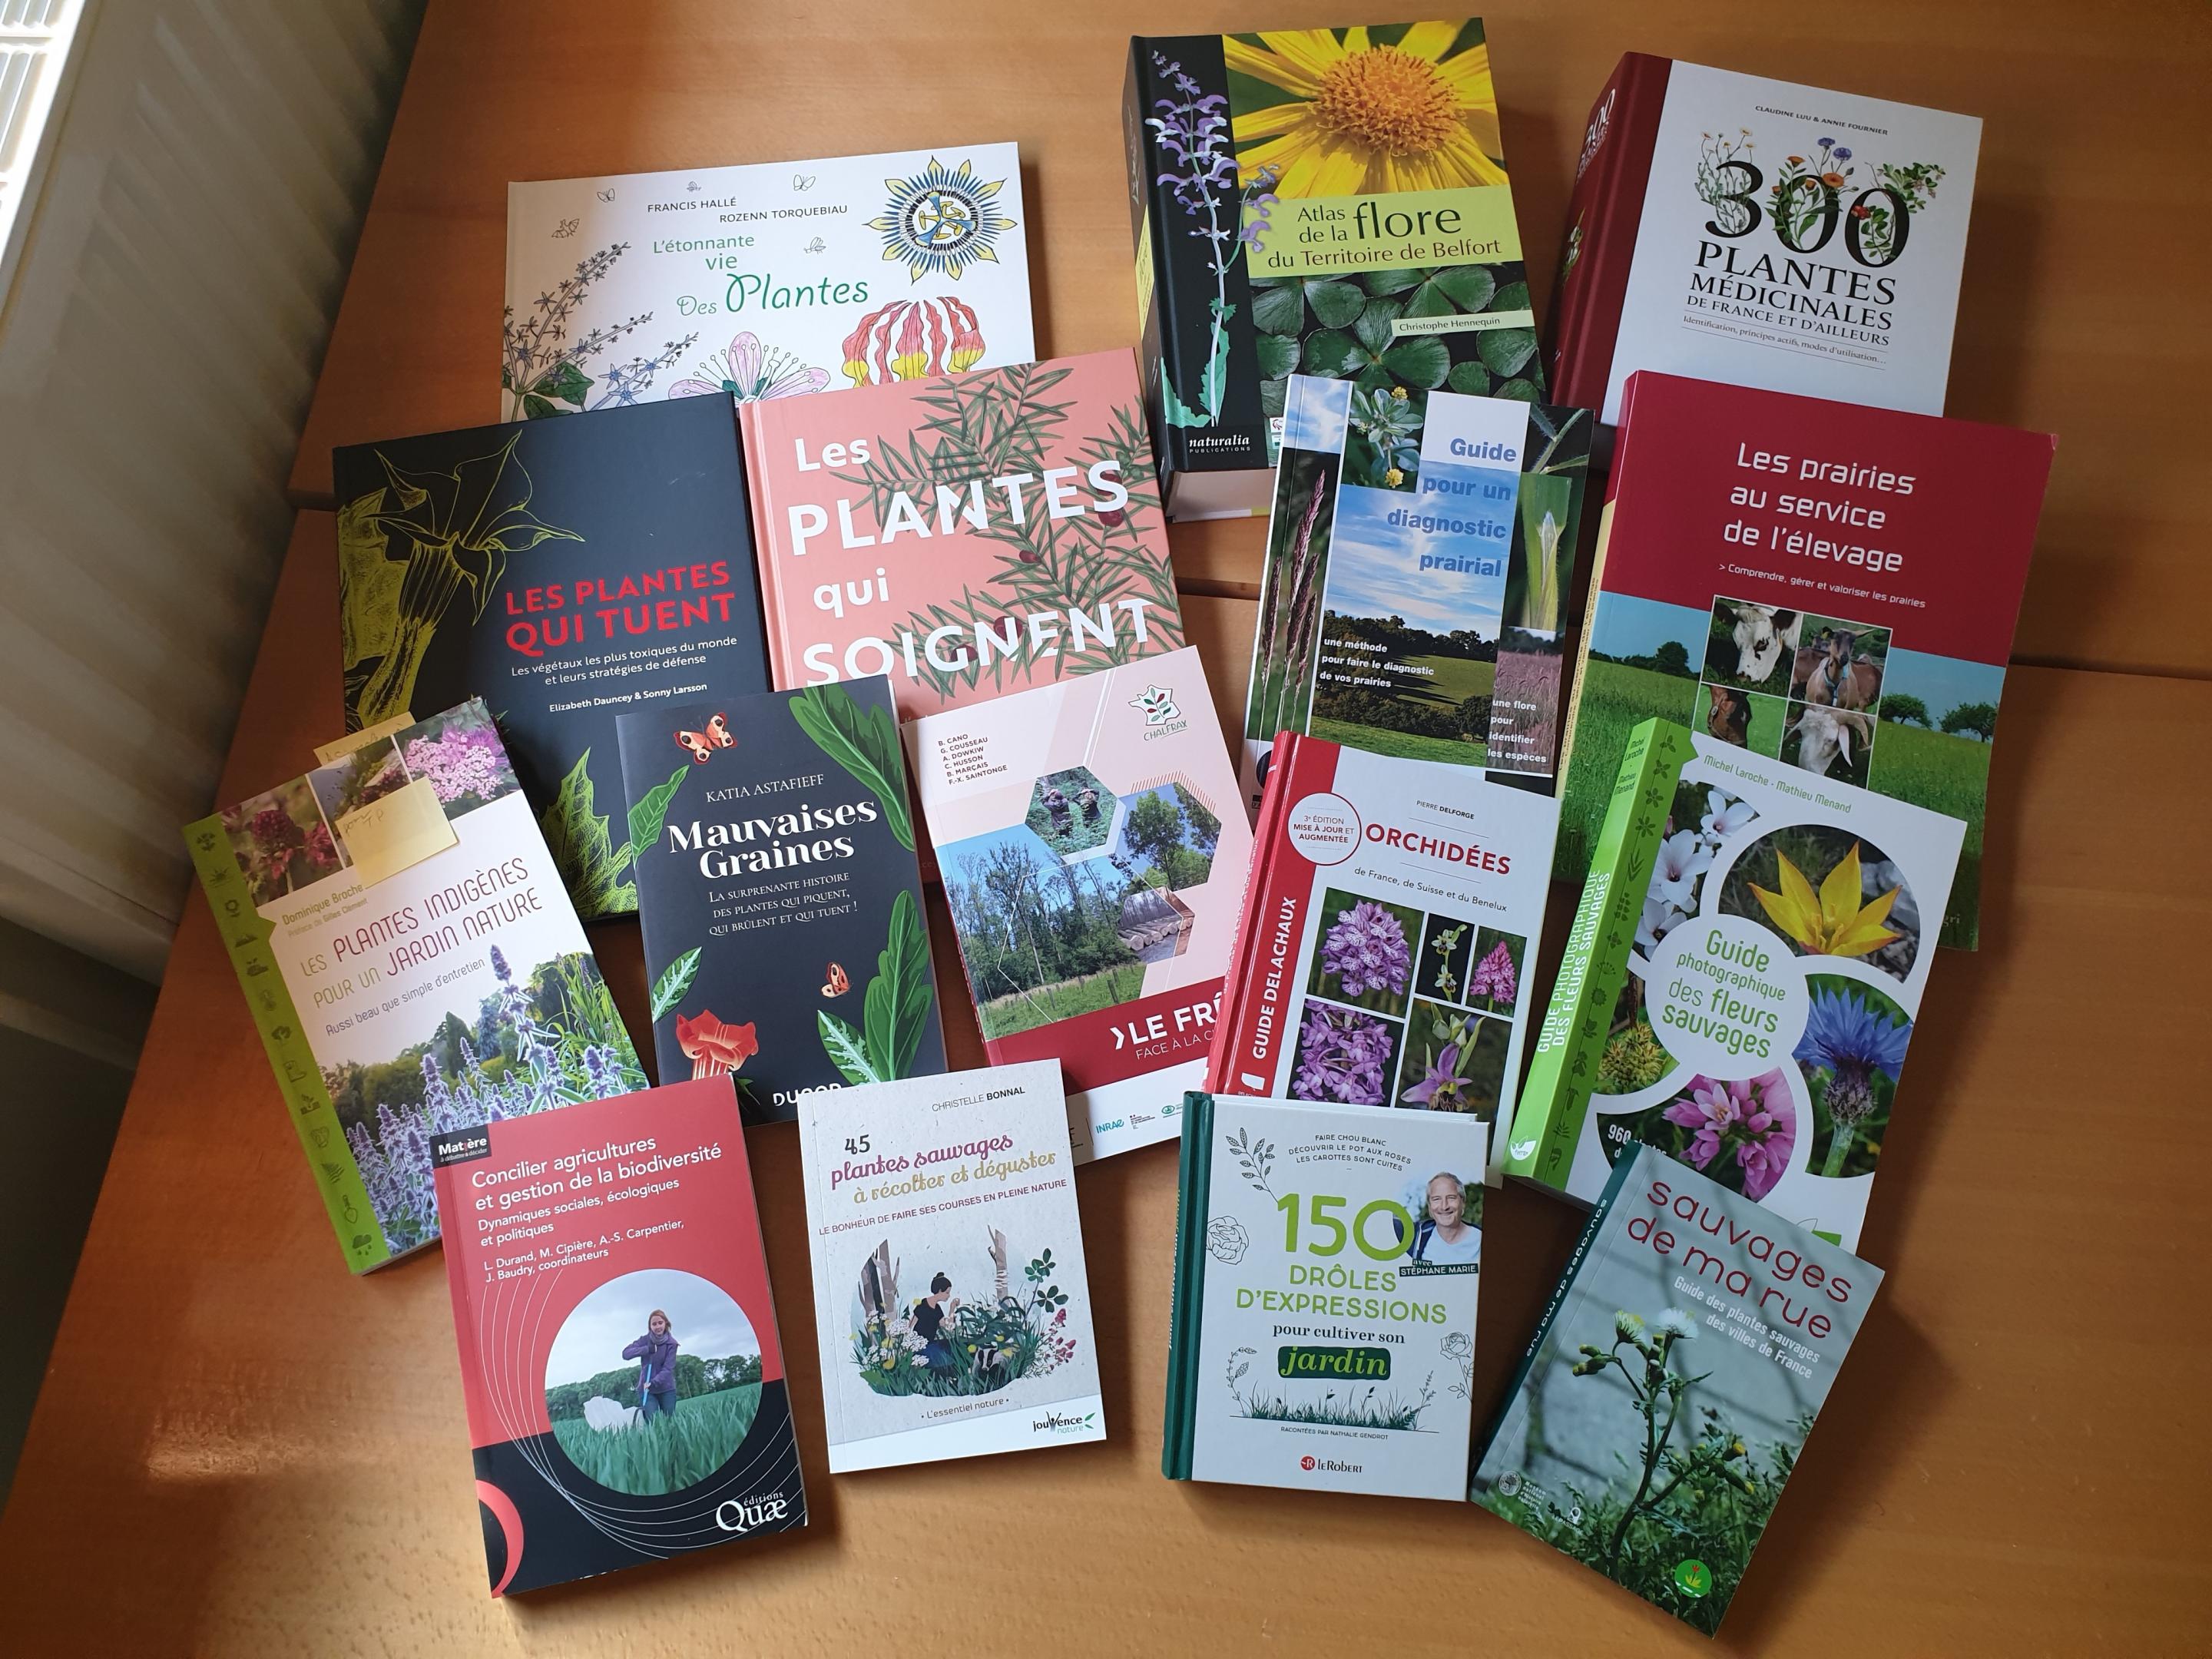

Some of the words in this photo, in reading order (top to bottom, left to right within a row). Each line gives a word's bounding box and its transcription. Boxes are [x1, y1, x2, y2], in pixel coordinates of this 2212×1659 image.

[1755, 105, 1794, 118] CLAUDINE
[1796, 113, 1811, 121] LUU
[1821, 118, 1845, 128] ANNIE
[1848, 123, 1888, 135] FOURNIER
[647, 200, 697, 213] FRANCIS
[700, 197, 737, 209] HALLÉ
[720, 211, 767, 223] ROZENN
[771, 204, 847, 220] TORQUEBIAU
[1297, 205, 1346, 223] Atlas
[1299, 227, 1324, 243] de
[1332, 225, 1348, 241] la
[1353, 202, 1462, 240] flore
[1705, 161, 1909, 268] 300
[654, 234, 754, 253] L'étonnante
[706, 253, 737, 270] vie
[1268, 251, 1294, 268] du
[1300, 247, 1393, 266] Territoire
[1400, 243, 1425, 260] de
[1433, 239, 1502, 257] Belfort
[1694, 240, 1896, 305] PLANTES
[677, 295, 717, 316] Des
[727, 273, 868, 312] Plantes
[1690, 273, 1892, 330] MÉDICINALES
[1399, 320, 1449, 332] Christophe
[1451, 317, 1501, 329] Hennequin
[1687, 295, 1707, 308] DE
[1712, 301, 1773, 323] FRANCE
[1778, 315, 1796, 327] ET
[1801, 320, 1889, 346] D'AILLEURS
[795, 438, 871, 472] Les
[1188, 434, 1250, 447] naturalia
[1450, 438, 1516, 462] Guide
[1737, 442, 1791, 474] Les
[1800, 459, 1916, 495] prairies
[1422, 477, 1476, 495] pour
[1483, 485, 1511, 500] un
[787, 459, 1129, 556] PLANTES
[1387, 508, 1506, 538] diagnostic
[1730, 485, 1767, 509] au
[1776, 495, 1886, 529] service
[1724, 519, 1760, 546] de
[1770, 525, 1903, 572] l'élevage
[1419, 555, 1502, 577] prairial
[505, 584, 565, 615] LES
[576, 560, 730, 605] PLANTES
[813, 568, 889, 618] qui
[1790, 576, 1815, 588] gérer
[1817, 581, 1827, 590] et
[1830, 584, 1869, 598] valoriser
[1873, 591, 1886, 601] les
[1889, 594, 1926, 608] prairies
[505, 614, 584, 657] QUI
[596, 592, 735, 639] TUENT
[803, 598, 1154, 686] SOIGNENT
[549, 698, 591, 713] Elizabeth
[594, 694, 633, 707] Dauncey
[643, 688, 671, 701] Sonny
[674, 683, 707, 694] Larsson
[1513, 700, 1536, 710] flore
[947, 734, 968, 743] CANO
[1489, 731, 1535, 744] identifier
[1491, 717, 1513, 725] pour
[952, 746, 984, 759] DOWKIW
[1487, 749, 1502, 757] les
[1505, 751, 1547, 763] espèces
[706, 786, 750, 803] KATIA
[753, 773, 824, 796] ASTAFIEFF
[965, 765, 1008, 780] SAINTONGE
[1704, 754, 1734, 773] Michel
[1735, 767, 1769, 786] Laroche
[1776, 780, 1813, 800] Mathieu
[1814, 793, 1852, 813] Menand
[667, 800, 877, 854] Mauvaises
[1313, 815, 1344, 825] ÉDITION
[1416, 800, 1439, 811] PIERRE
[1439, 806, 1475, 820] DELFORGE
[1293, 823, 1313, 832] MISE
[1314, 823, 1320, 832] À
[1322, 826, 1343, 834] JOUR
[1299, 832, 1349, 843] AUGMENTÉE
[700, 836, 855, 879] Graines
[1366, 823, 1512, 875] ORCHIDÉES
[281, 899, 330, 926] Dominique
[333, 884, 364, 902] Broche
[300, 953, 327, 978] LES
[333, 907, 419, 963] PLANTES
[424, 857, 528, 921] INDIGÈNES
[313, 979, 355, 1009] POUR
[360, 967, 381, 988] UN
[387, 925, 459, 976] JARDIN
[462, 887, 542, 941] NATURE
[1263, 896, 1296, 1002] DELACHAUX
[1706, 929, 1770, 972] Guide
[1676, 952, 1786, 1001] photographique
[1669, 978, 1704, 1006] des
[1710, 988, 1778, 1033] fleurs
[1128, 1015, 1168, 1045] LE
[1253, 1003, 1275, 1060] GUIDE
[1662, 1005, 1771, 1058] sauvages
[932, 1094, 985, 1112] CHRISTELLE
[986, 1086, 1025, 1101] BONNAL
[831, 1155, 909, 1190] plantes
[914, 1134, 1014, 1169] sauvages
[845, 1134, 870, 1155] 45
[472, 1160, 548, 1189] Concilier
[554, 1137, 657, 1173] agricultures
[475, 1194, 494, 1211] et
[498, 1180, 564, 1210] gestion
[569, 1171, 593, 1190] de
[598, 1167, 613, 1184] la
[618, 1143, 722, 1179] biodiversité
[853, 1187, 868, 1204] à
[871, 1174, 946, 1200] récolter
[951, 1165, 969, 1184] et
[974, 1151, 1056, 1181] déguster
[1277, 1193, 1415, 1261] 150
[1647, 1181, 1852, 1303] sauvages
[1290, 1263, 1396, 1293] DRÔLES
[1401, 1266, 1446, 1277] STÉPHANE
[1449, 1264, 1476, 1273] MARIE
[1628, 1217, 1675, 1254] de
[1683, 1247, 1752, 1297] ma
[1759, 1287, 1831, 1338] rue
[1236, 1288, 1447, 1324] D'EXPRESSIONS
[1674, 1276, 1704, 1302] Guide
[1706, 1295, 1727, 1312] des
[1727, 1302, 1768, 1335] plantes
[1769, 1326, 1821, 1363] sauvages
[1273, 1324, 1310, 1336] pour
[1313, 1326, 1376, 1341] cultiver
[1379, 1333, 1405, 1343] son
[1705, 1314, 1727, 1332] des
[1727, 1323, 1757, 1348] villes
[1758, 1340, 1772, 1358] de
[1774, 1349, 1813, 1379] France
[1280, 1346, 1387, 1376] jardin
[743, 1491, 784, 1507] éditions
